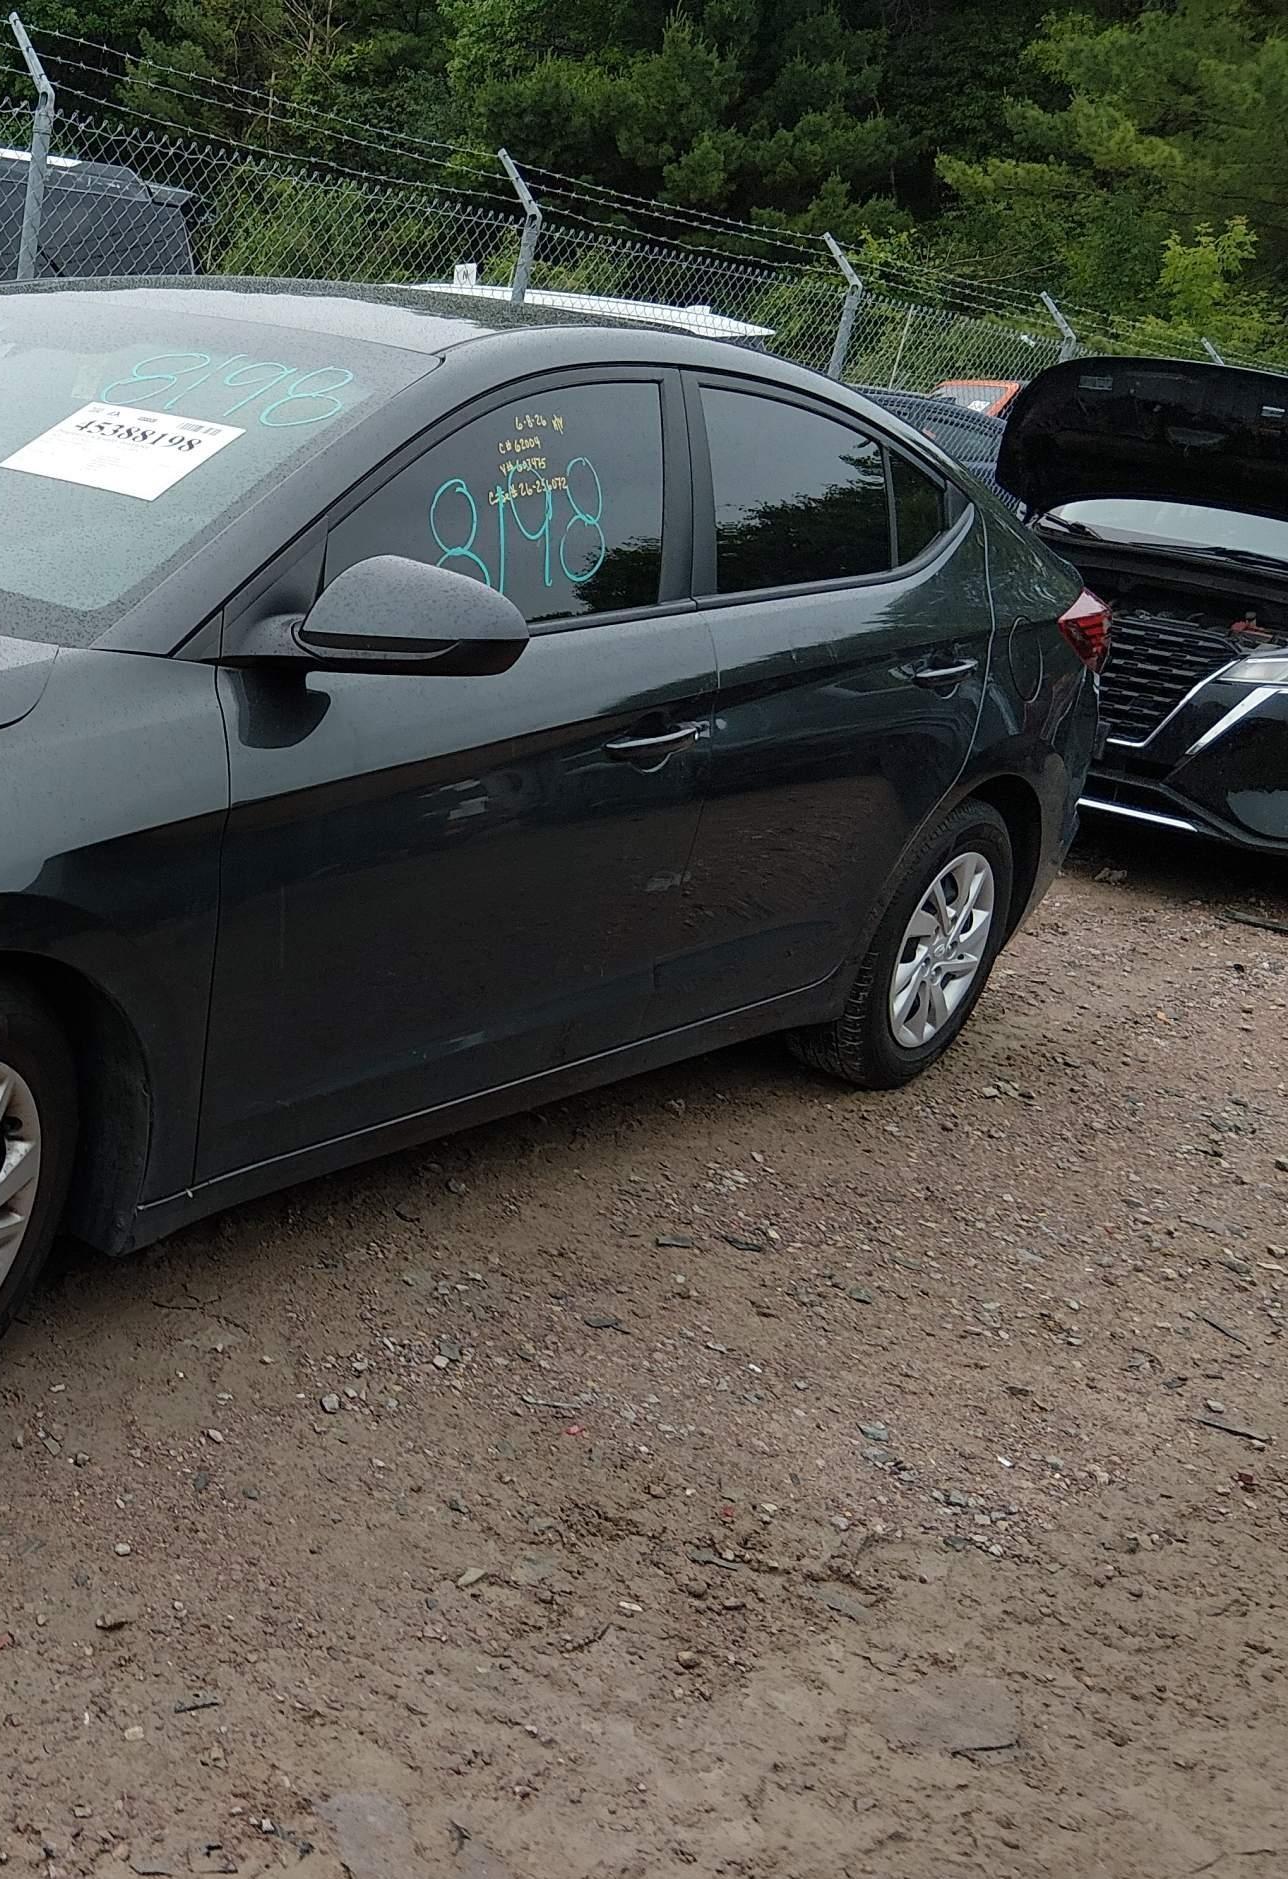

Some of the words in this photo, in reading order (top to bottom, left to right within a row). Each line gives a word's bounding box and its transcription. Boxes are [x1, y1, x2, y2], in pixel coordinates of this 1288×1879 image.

[101, 353, 355, 427] 8198
[74, 419, 202, 452] 45388198
[429, 456, 606, 594] 8198
